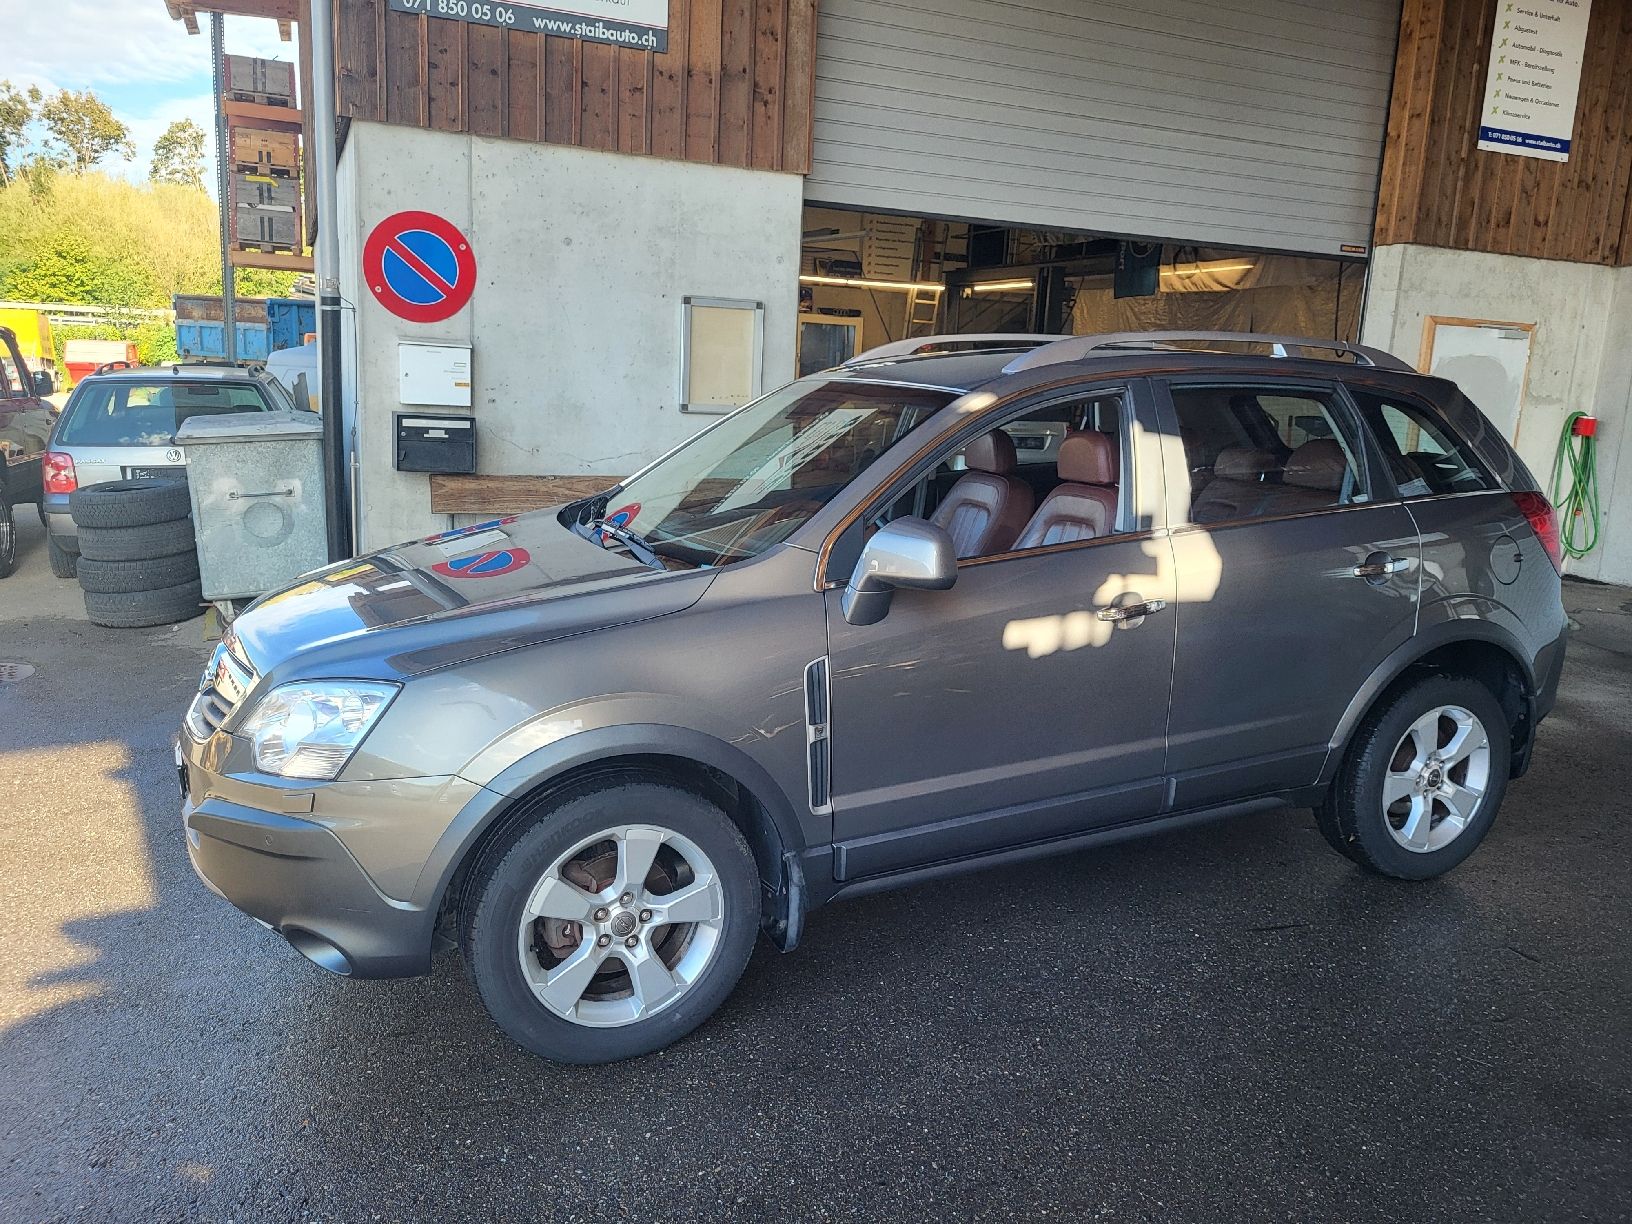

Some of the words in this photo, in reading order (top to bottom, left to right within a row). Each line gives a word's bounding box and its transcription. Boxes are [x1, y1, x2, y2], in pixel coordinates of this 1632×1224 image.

[1517, 7, 1534, 17] Service
[438, 0, 468, 17] 850
[471, 3, 492, 20] 05
[495, 7, 515, 24] 06
[532, 17, 657, 48] www.staibauto.ch
[1512, 42, 1537, 52] Automobil
